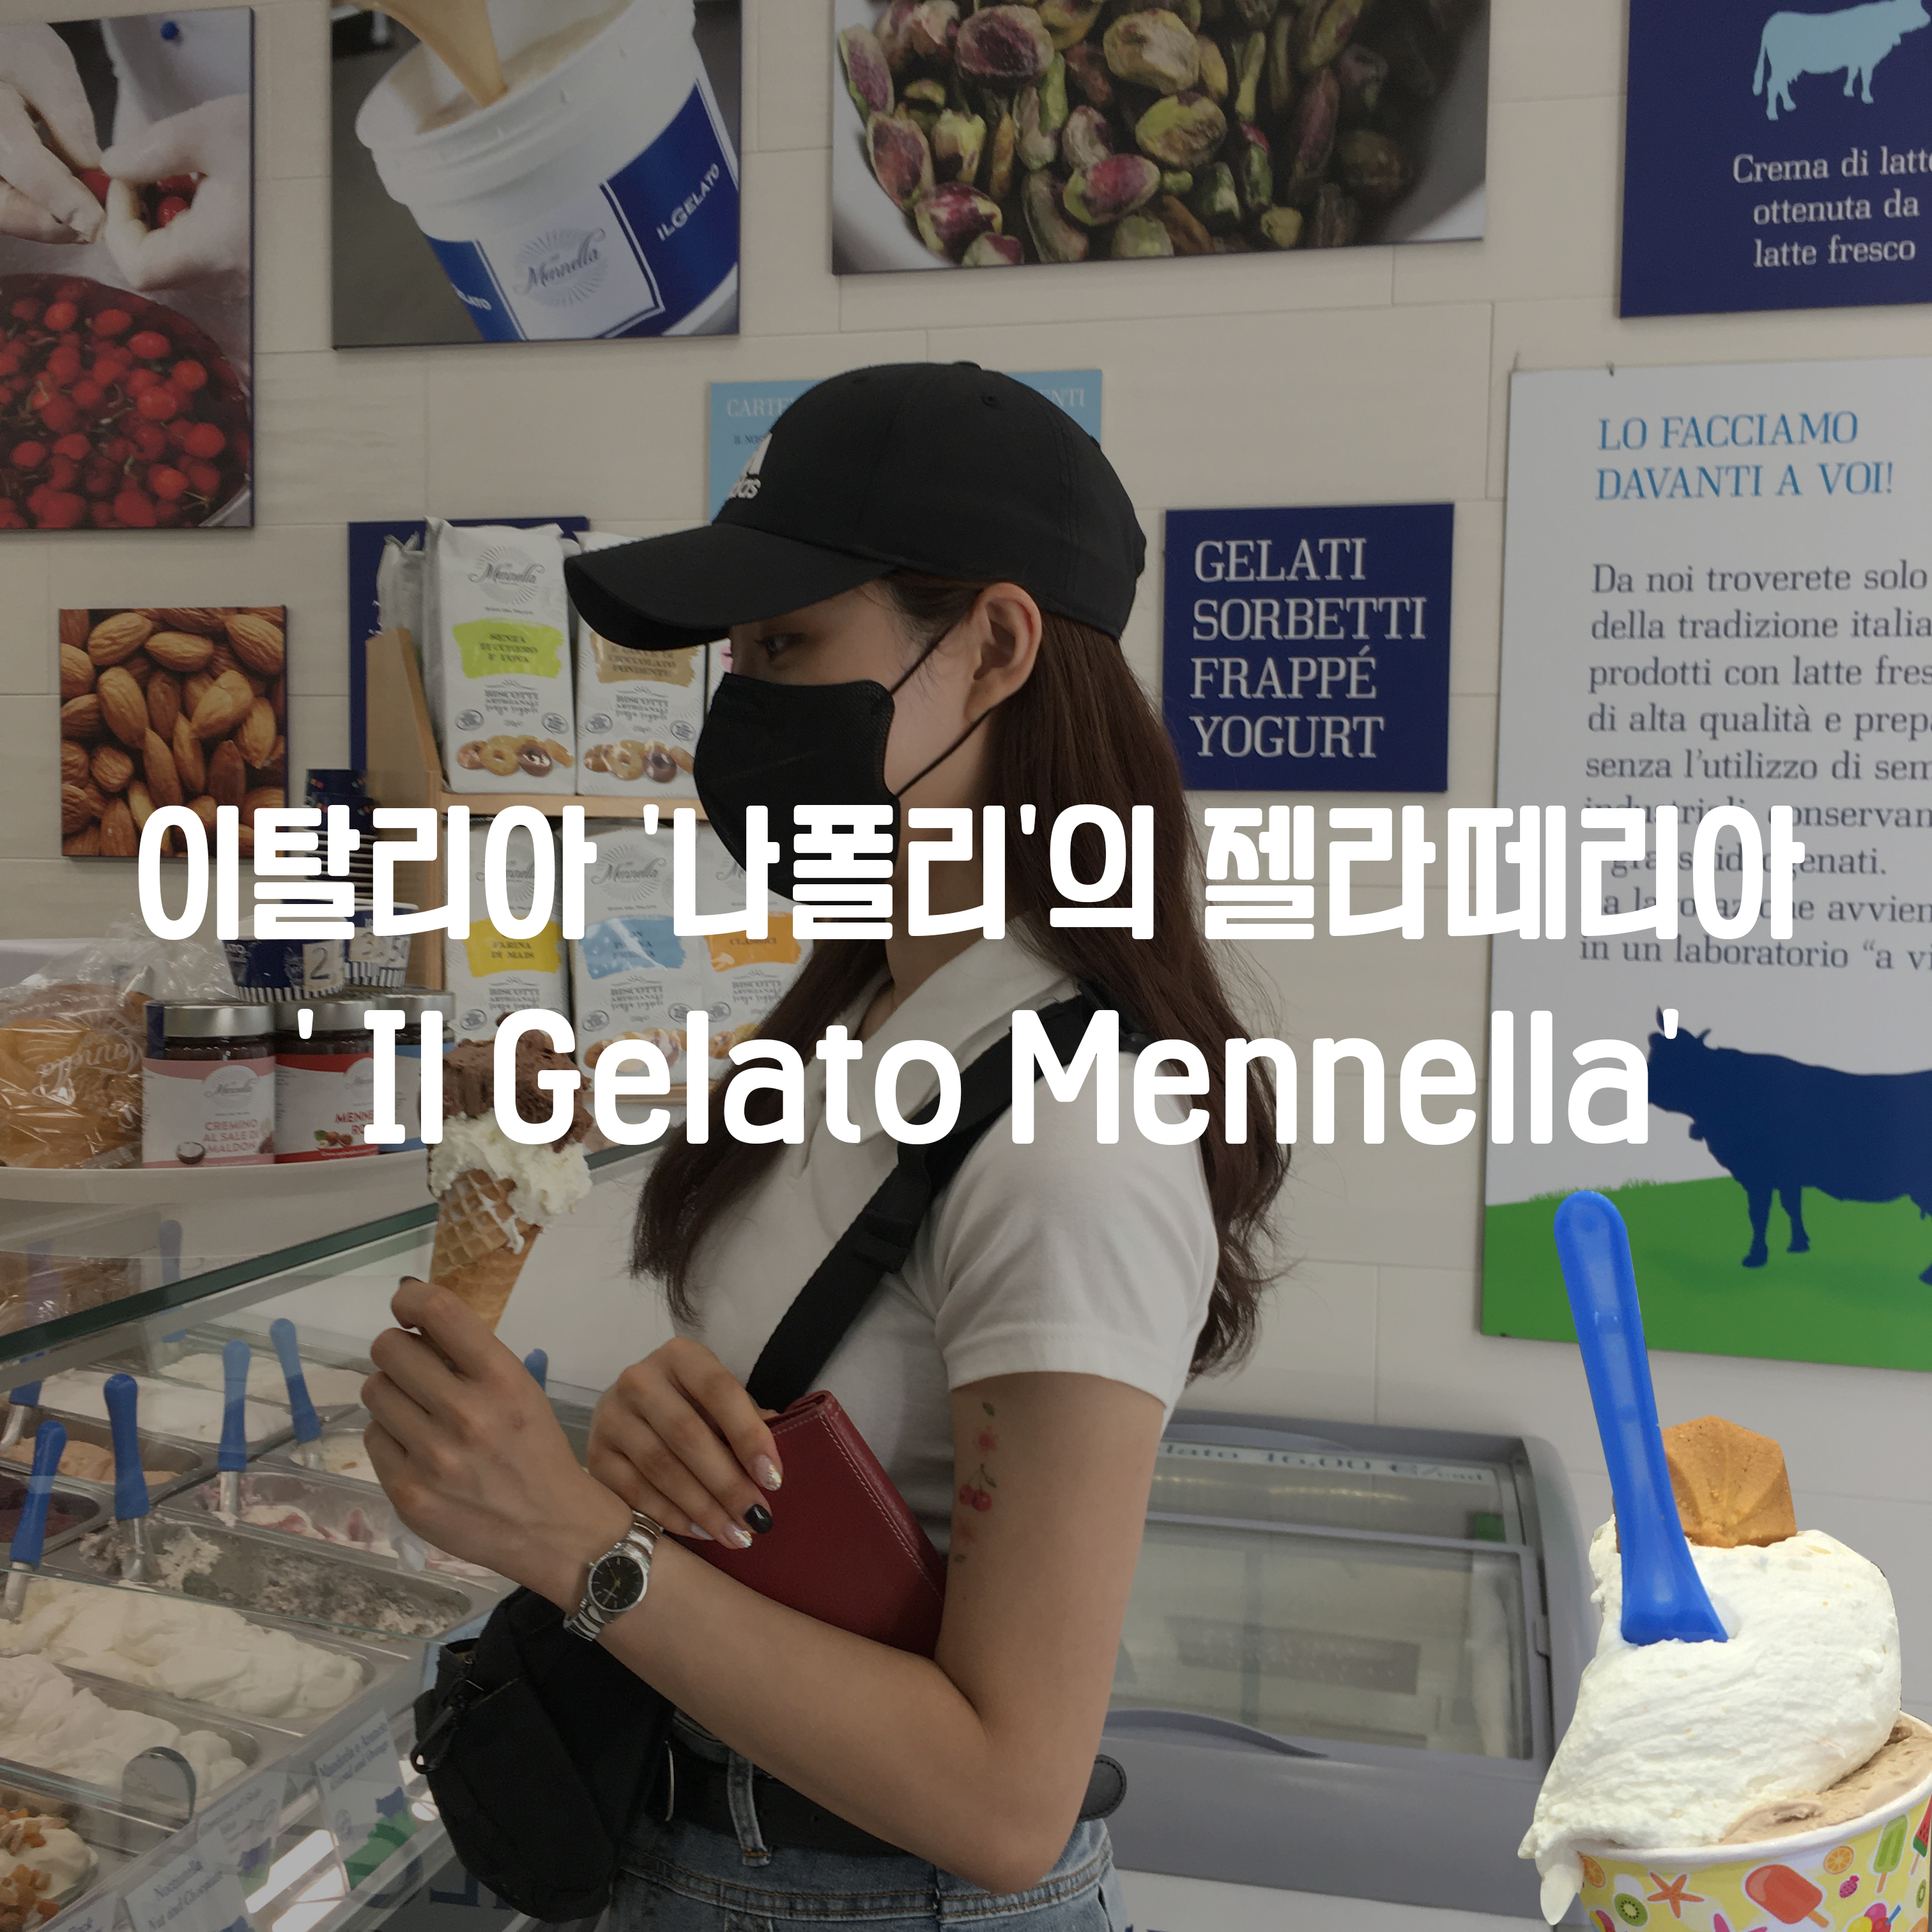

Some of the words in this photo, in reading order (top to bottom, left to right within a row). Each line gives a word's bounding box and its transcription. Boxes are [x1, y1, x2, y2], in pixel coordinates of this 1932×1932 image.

[1733, 153, 1829, 183] Crema
[1841, 148, 1869, 178] di
[1753, 195, 1872, 225] ottenuta
[1883, 188, 1919, 218] da
[1753, 238, 1816, 268] latte
[1827, 233, 1916, 264] fresco
[1597, 416, 1648, 451] LO
[1661, 410, 1859, 448] FACCIAMO
[1595, 463, 1764, 501] DAVANTI
[1775, 464, 1804, 497] A
[1816, 461, 1895, 496] VOI!
[1194, 538, 1367, 583] GELATI
[1591, 563, 1635, 594] Da
[1645, 565, 1694, 593] noi
[1706, 566, 1851, 593] troverete
[1863, 559, 1929, 591] solo
[1192, 597, 1428, 641] SORBETTI
[1591, 610, 1666, 641] della
[1678, 608, 1839, 640] tradizione
[1850, 607, 1932, 639] italia
[1190, 644, 1377, 700] FRAPPÉ
[1587, 656, 1712, 695] prodotti
[1724, 664, 1780, 687] con
[1791, 655, 1862, 686] latte
[1874, 654, 1932, 686] fres
[1189, 715, 1385, 758] YOGURT
[1587, 702, 1617, 733] di
[1629, 702, 1687, 733] alta
[1699, 702, 1812, 742] qualità
[1824, 711, 1842, 733] e
[1853, 711, 1932, 742] prep
[1585, 756, 1673, 779] senza
[1684, 748, 1818, 781] l'utilizzo
[1830, 749, 1862, 781] di
[1827, 894, 1932, 923] avvien
[310, 947, 330, 980] 2
[1579, 935, 1611, 961] in
[1621, 940, 1662, 963] un
[1673, 933, 1849, 967] laboratorio
